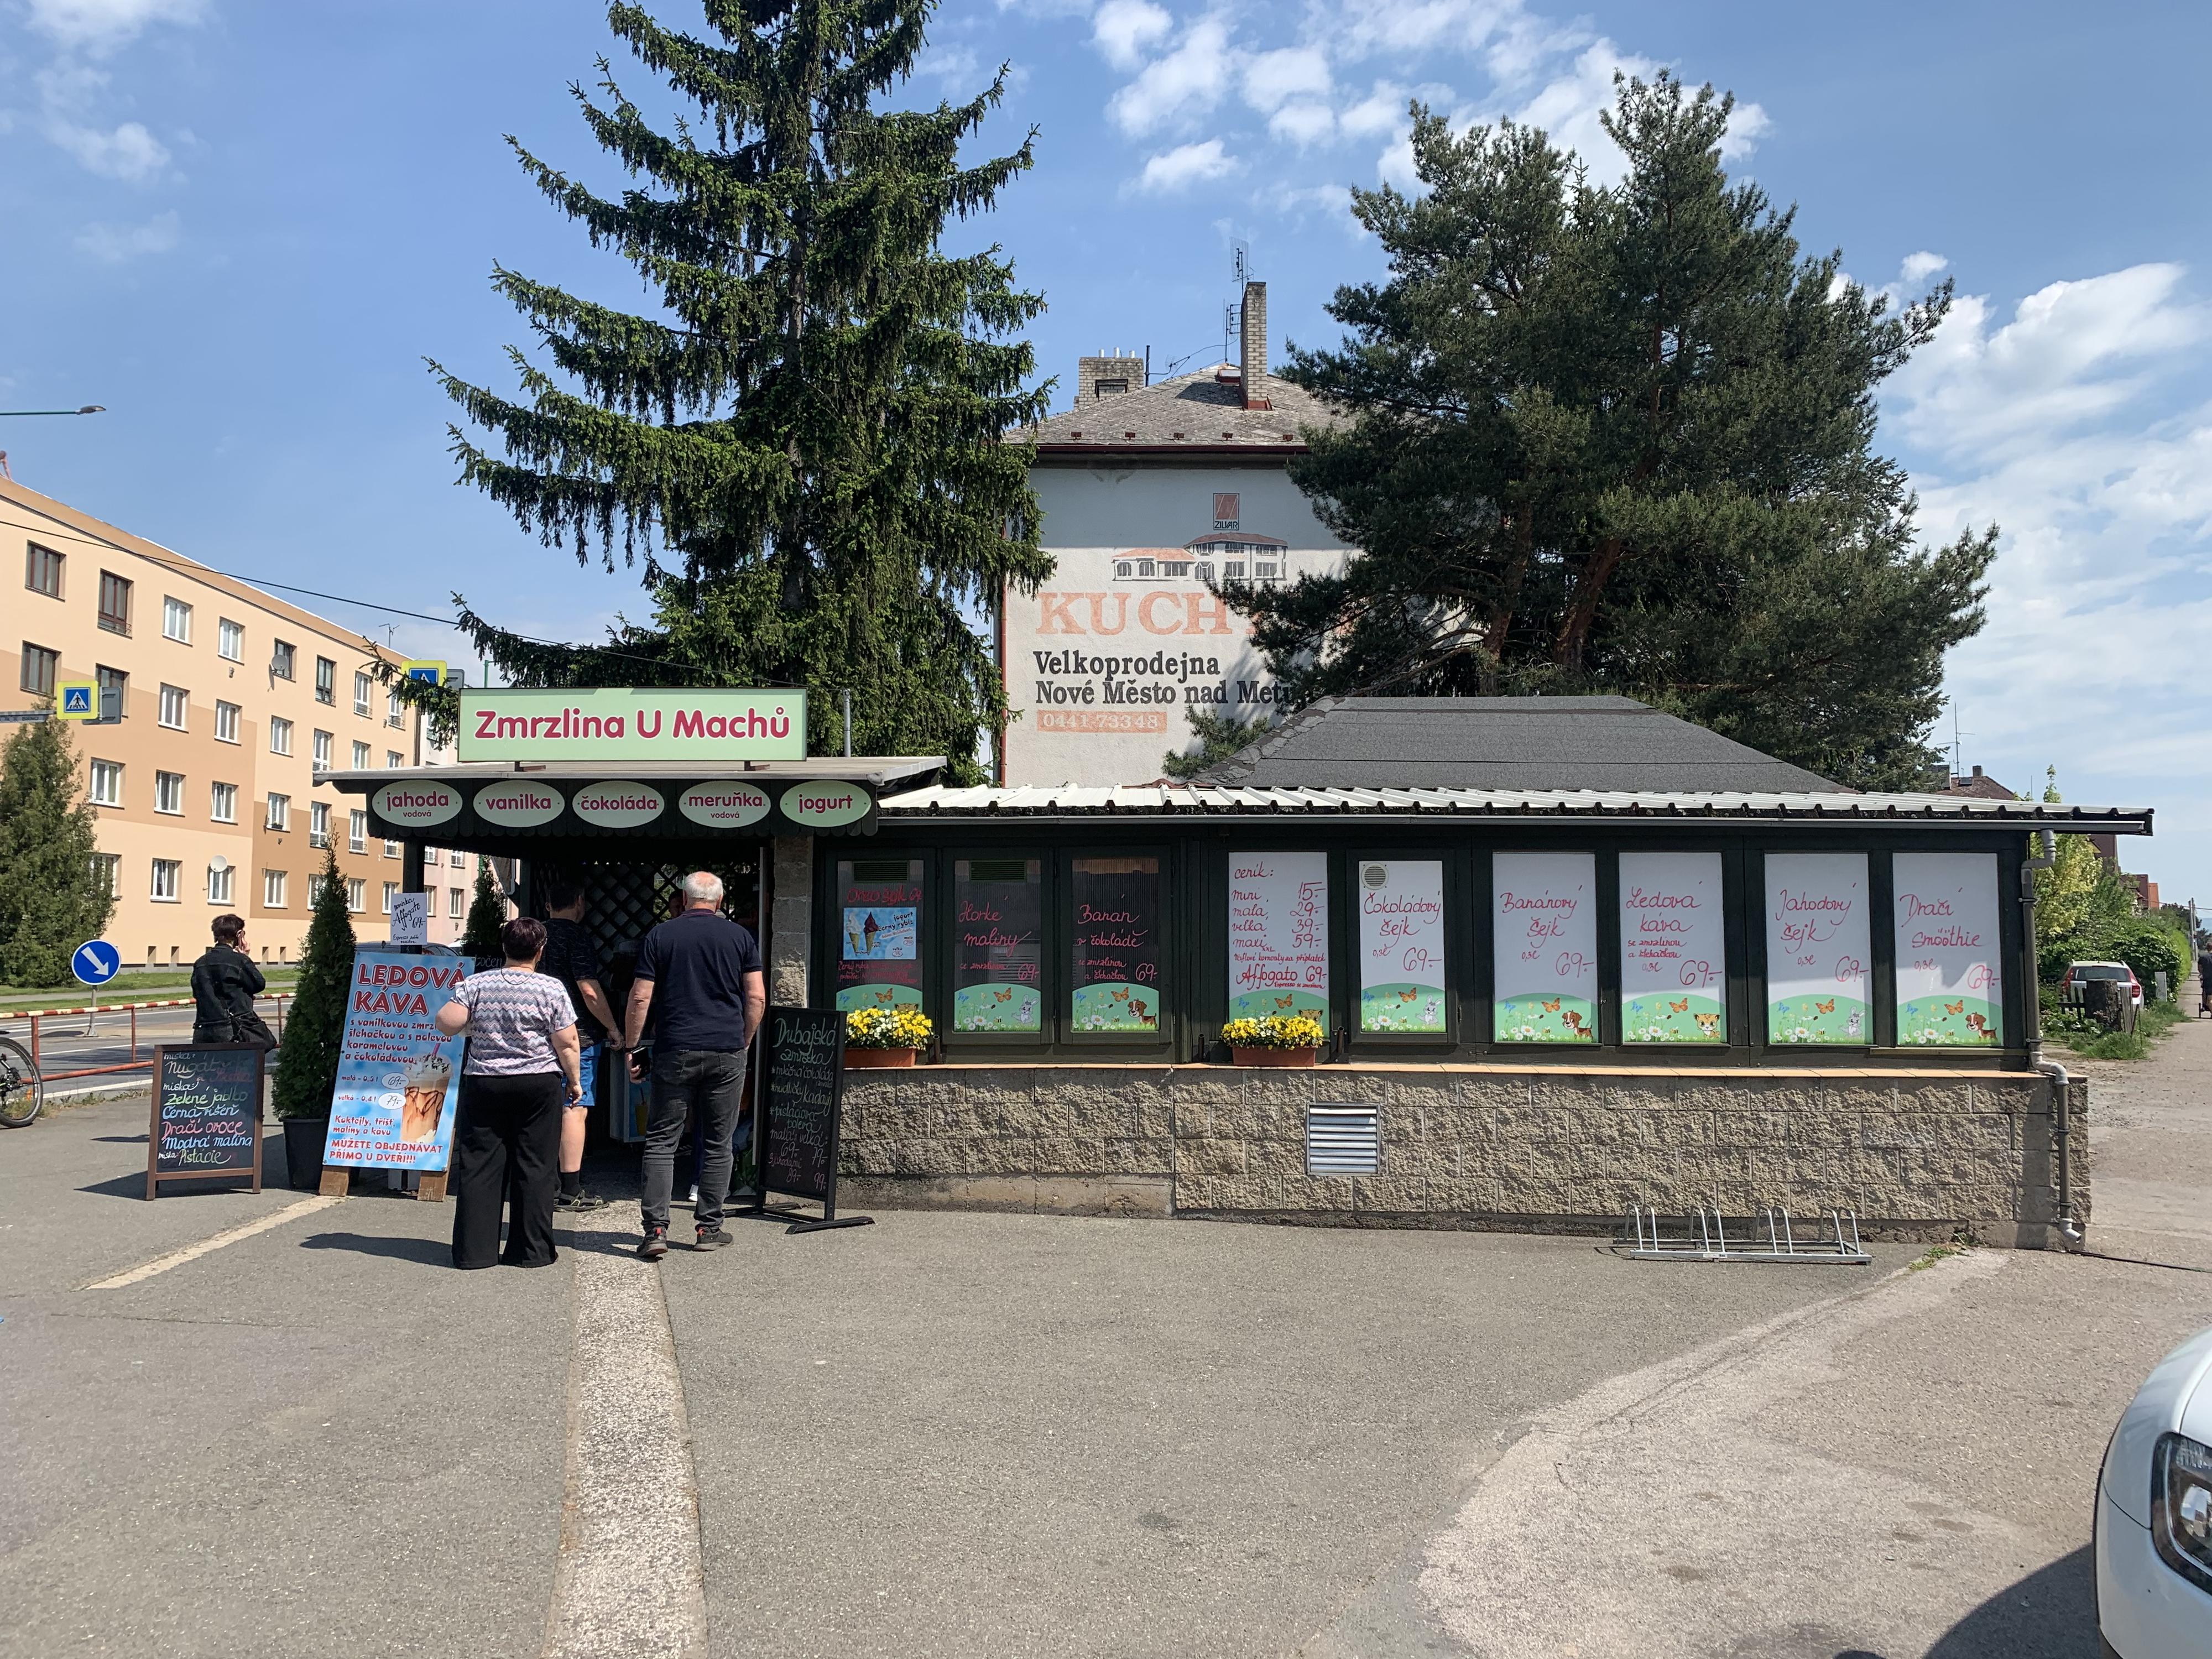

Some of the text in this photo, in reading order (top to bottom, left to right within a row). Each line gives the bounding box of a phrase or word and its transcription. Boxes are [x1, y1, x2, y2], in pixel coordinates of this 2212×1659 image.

[1214, 521, 1238, 529] ZILVAR
[1035, 591, 1262, 635] KUCH
[1033, 650, 1220, 684] Velkoprodejna
[1036, 679, 1294, 704] Nové Město nad Metu
[474, 707, 790, 739] Zmrzlina U Machů
[386, 791, 450, 811] jahoda
[486, 792, 552, 811] vanilka
[581, 794, 657, 811] čokoláda
[688, 790, 763, 808] meruňka
[799, 794, 853, 814] jogurt
[403, 810, 432, 818] vodová
[710, 811, 740, 820] vodová
[1500, 885, 1583, 920] Banánový
[1626, 880, 1703, 909] Ledová
[959, 895, 1009, 922] Horké
[1077, 894, 1140, 925] Banán
[1364, 890, 1441, 925] Čokoládový
[1775, 883, 1856, 926] Jahodový
[1900, 886, 1963, 928] Dračí
[894, 911, 913, 922] jogurt
[1640, 912, 1694, 932] káva
[964, 927, 1031, 957] maliny
[1091, 929, 1148, 947] čokoládě
[1639, 936, 1688, 947] zmrzlinou
[475, 954, 502, 968] točen
[357, 961, 466, 990] LEDOVÁ
[1237, 963, 1298, 990] Affogato
[353, 985, 429, 1016] KÁVA
[358, 1018, 408, 1029] vanilkovou
[347, 1040, 408, 1051] karamelovou
[348, 1029, 395, 1040] šlehačkou
[415, 1032, 452, 1043] polevou
[773, 1017, 837, 1055] Dubajská
[354, 1052, 414, 1063] čokoládovou
[162, 1105, 202, 1120] Černá
[335, 1114, 371, 1126] Koktejly,
[161, 1118, 247, 1141] Dračí ovoce
[333, 1127, 360, 1136] maliny
[371, 1126, 391, 1136] kávu
[161, 1135, 253, 1150] Modrá malina
[331, 1136, 443, 1154] MŮŽETE OBJEDNÁVAT
[178, 1148, 231, 1166] Pistácie
[330, 1147, 362, 1160] PŘÍMO
[366, 1152, 373, 1161] U
